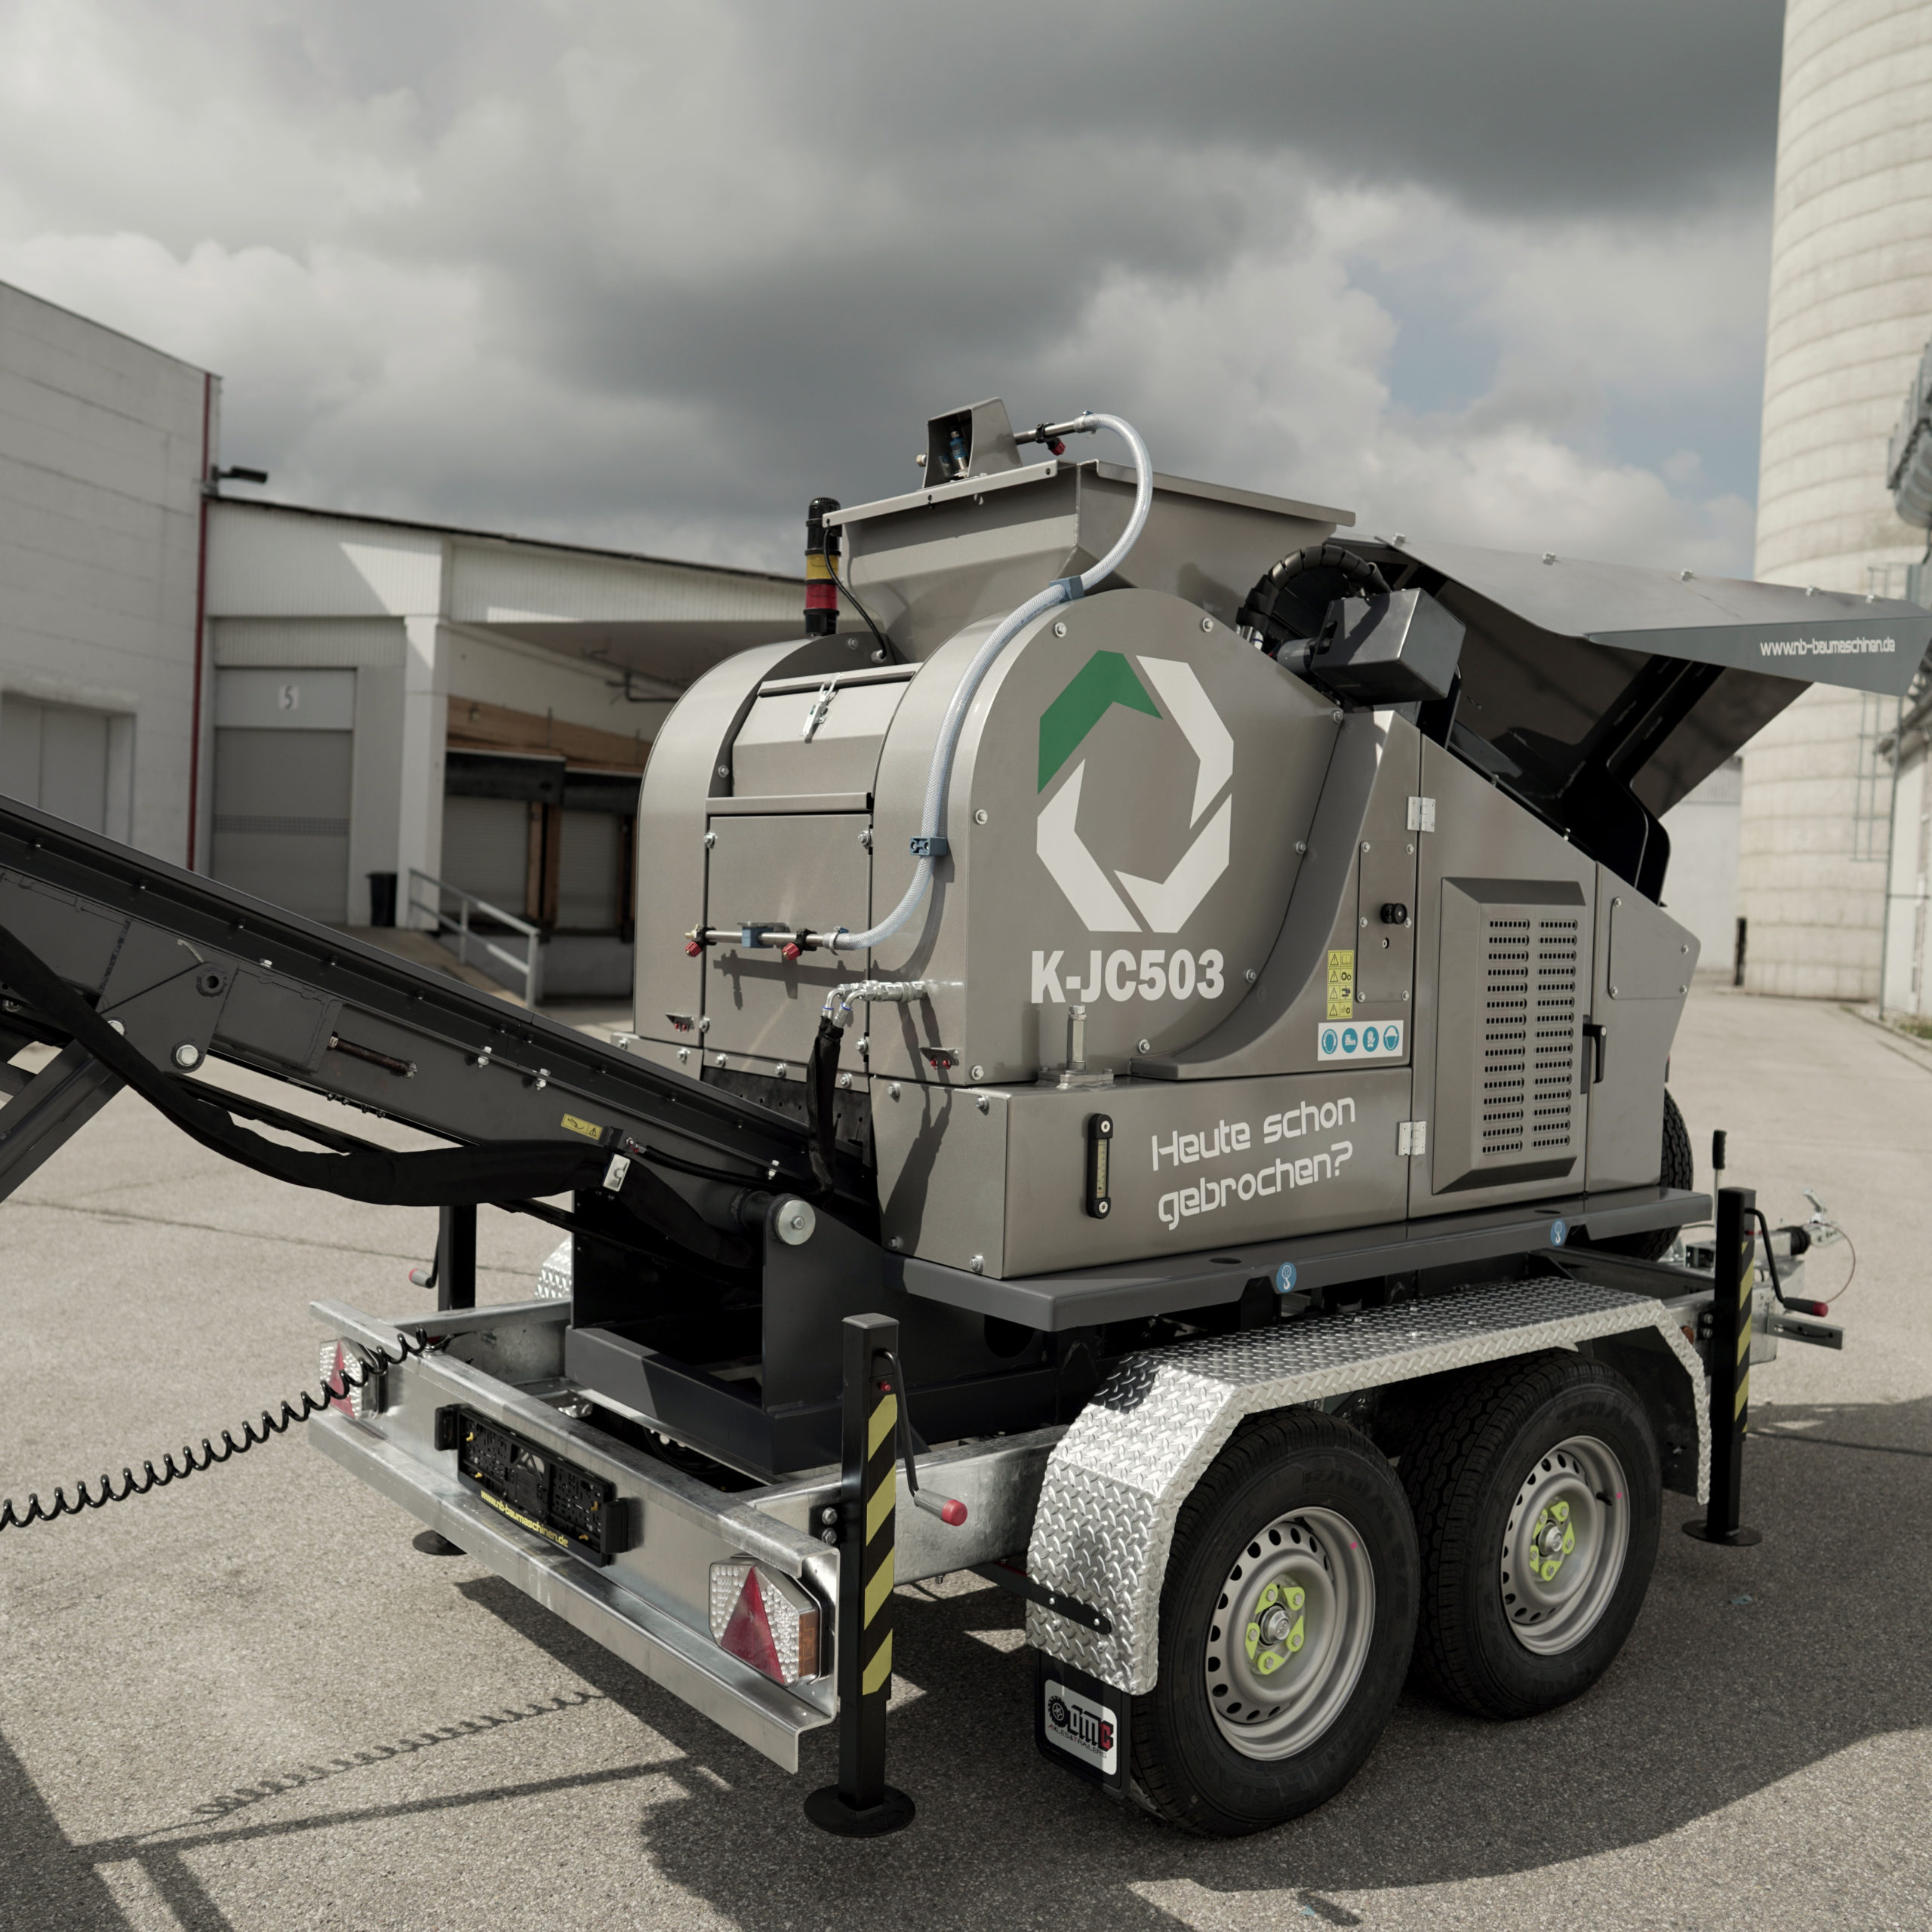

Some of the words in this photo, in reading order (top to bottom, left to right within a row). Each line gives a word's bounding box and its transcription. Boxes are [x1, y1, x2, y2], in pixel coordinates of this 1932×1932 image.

[1760, 635, 1896, 657] www.nb-baumaschinen.de
[284, 684, 294, 710] 5
[1030, 949, 1225, 1004] K-JC503
[1151, 1120, 1251, 1171] Heute
[1263, 1097, 1356, 1145] schon
[1157, 1140, 1354, 1231] gebrochen?
[481, 1489, 568, 1548] www.nb-baumaschinen.de
